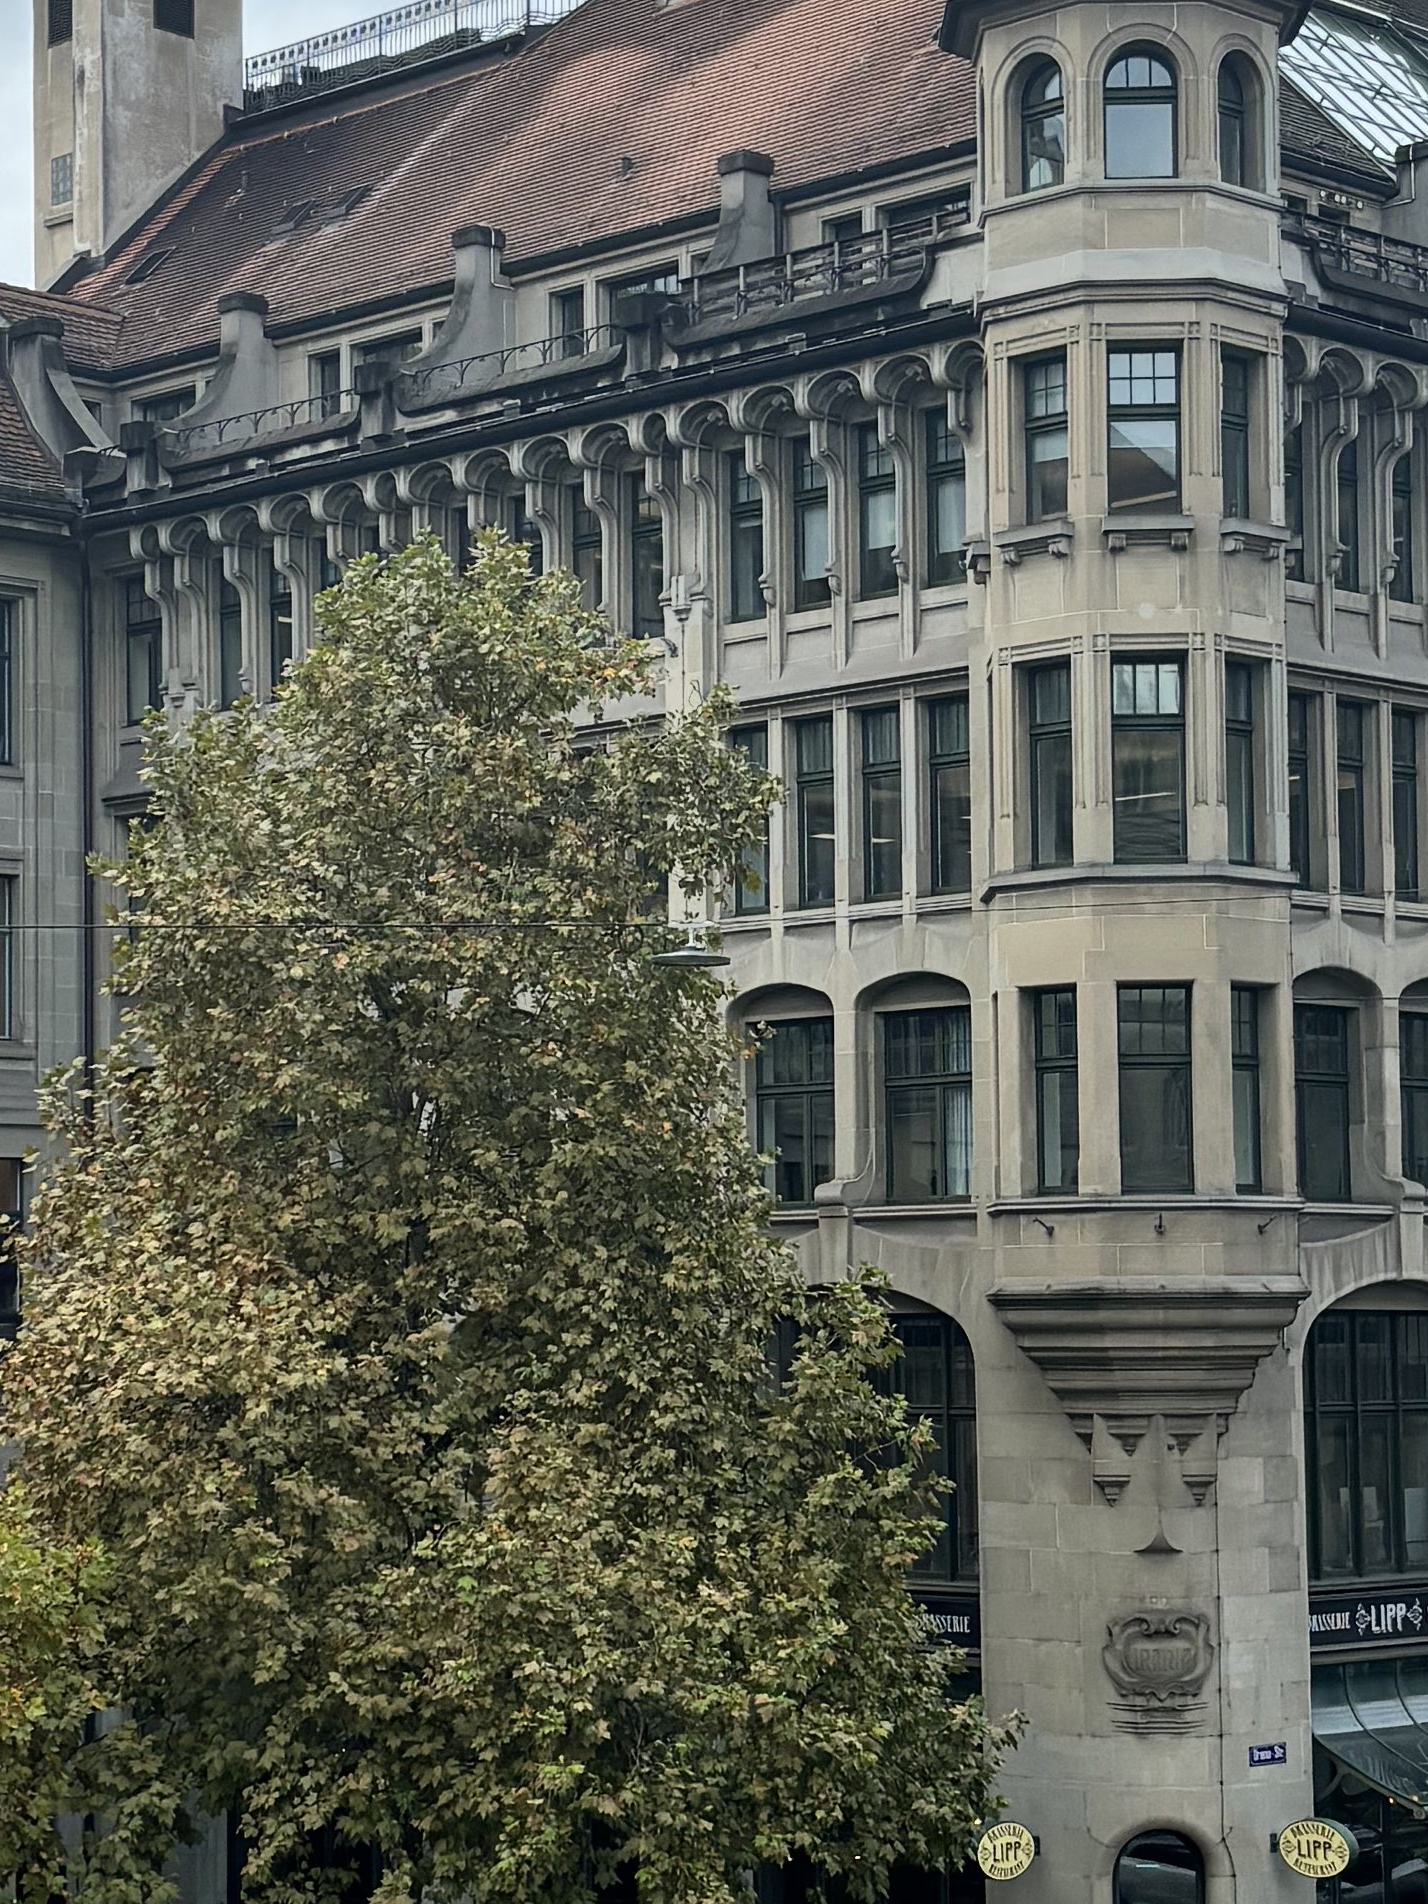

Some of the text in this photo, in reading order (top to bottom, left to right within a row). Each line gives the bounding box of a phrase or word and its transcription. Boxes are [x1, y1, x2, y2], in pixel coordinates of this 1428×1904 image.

[1371, 1603, 1407, 1633] LIPP
[993, 1841, 1021, 1863] LIPP
[1297, 1838, 1332, 1862] LIPP
